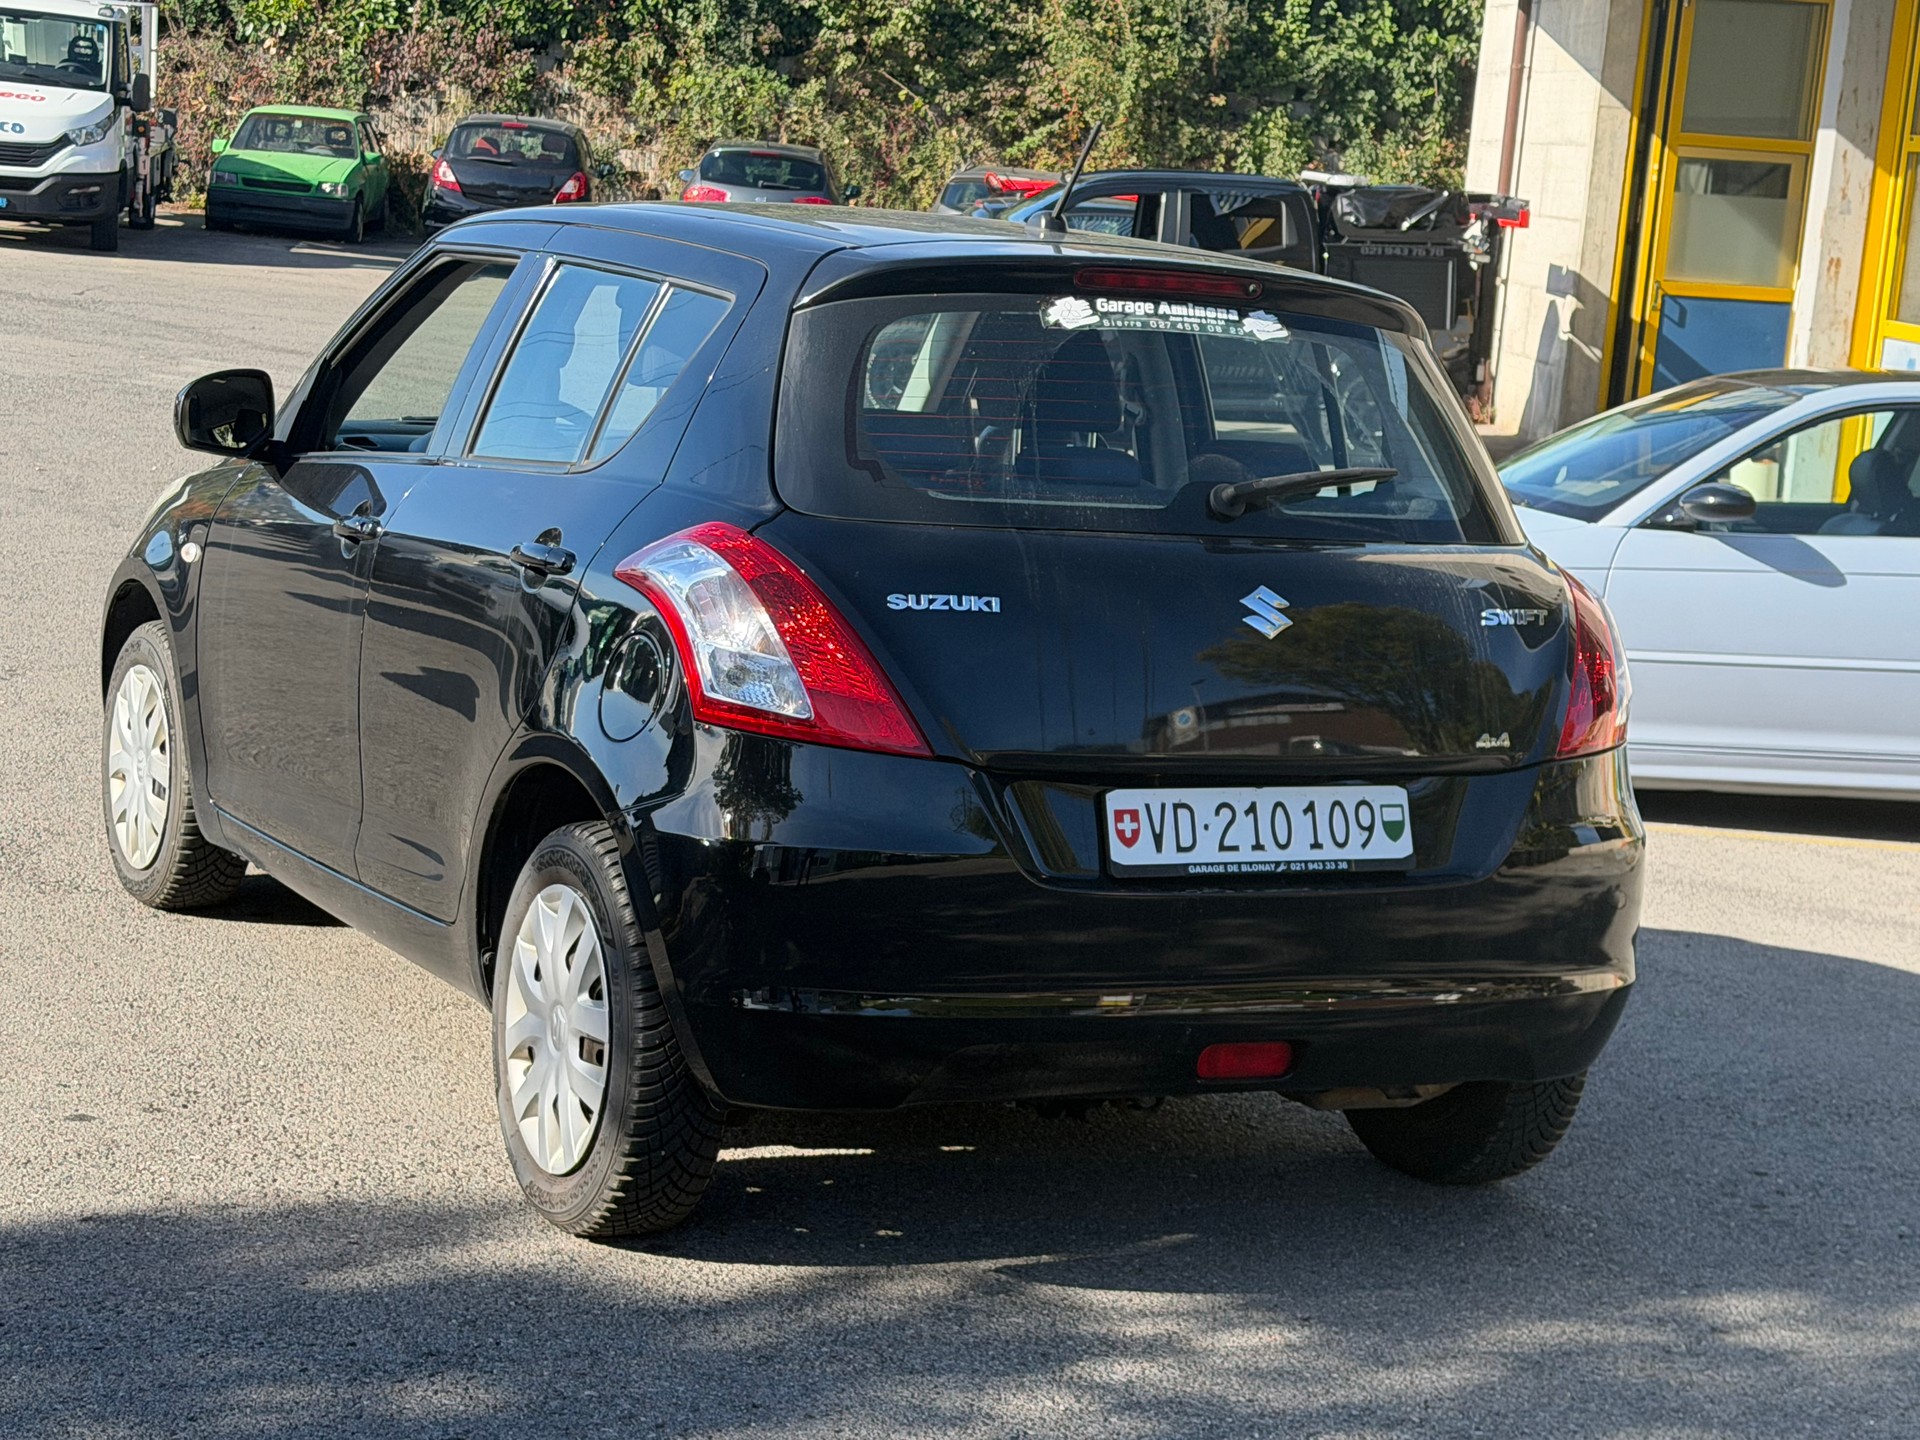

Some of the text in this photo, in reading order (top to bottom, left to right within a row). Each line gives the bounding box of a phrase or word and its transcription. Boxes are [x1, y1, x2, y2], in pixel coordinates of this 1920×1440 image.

[1096, 298, 1239, 320] Garage Aminona
[1103, 319, 1142, 327] Sierre
[1149, 320, 1171, 329] 027
[1176, 322, 1200, 331] 455
[1229, 327, 1244, 335] 23
[887, 593, 1000, 613] SUZUKI
[1481, 608, 1548, 626] SWIFT
[1188, 864, 1225, 873] GARAGE
[1227, 863, 1239, 872] DE
[1241, 862, 1276, 872] BLONAY
[1290, 862, 1305, 870] 021
[1308, 861, 1323, 870] 943
[1325, 861, 1336, 870] 33
